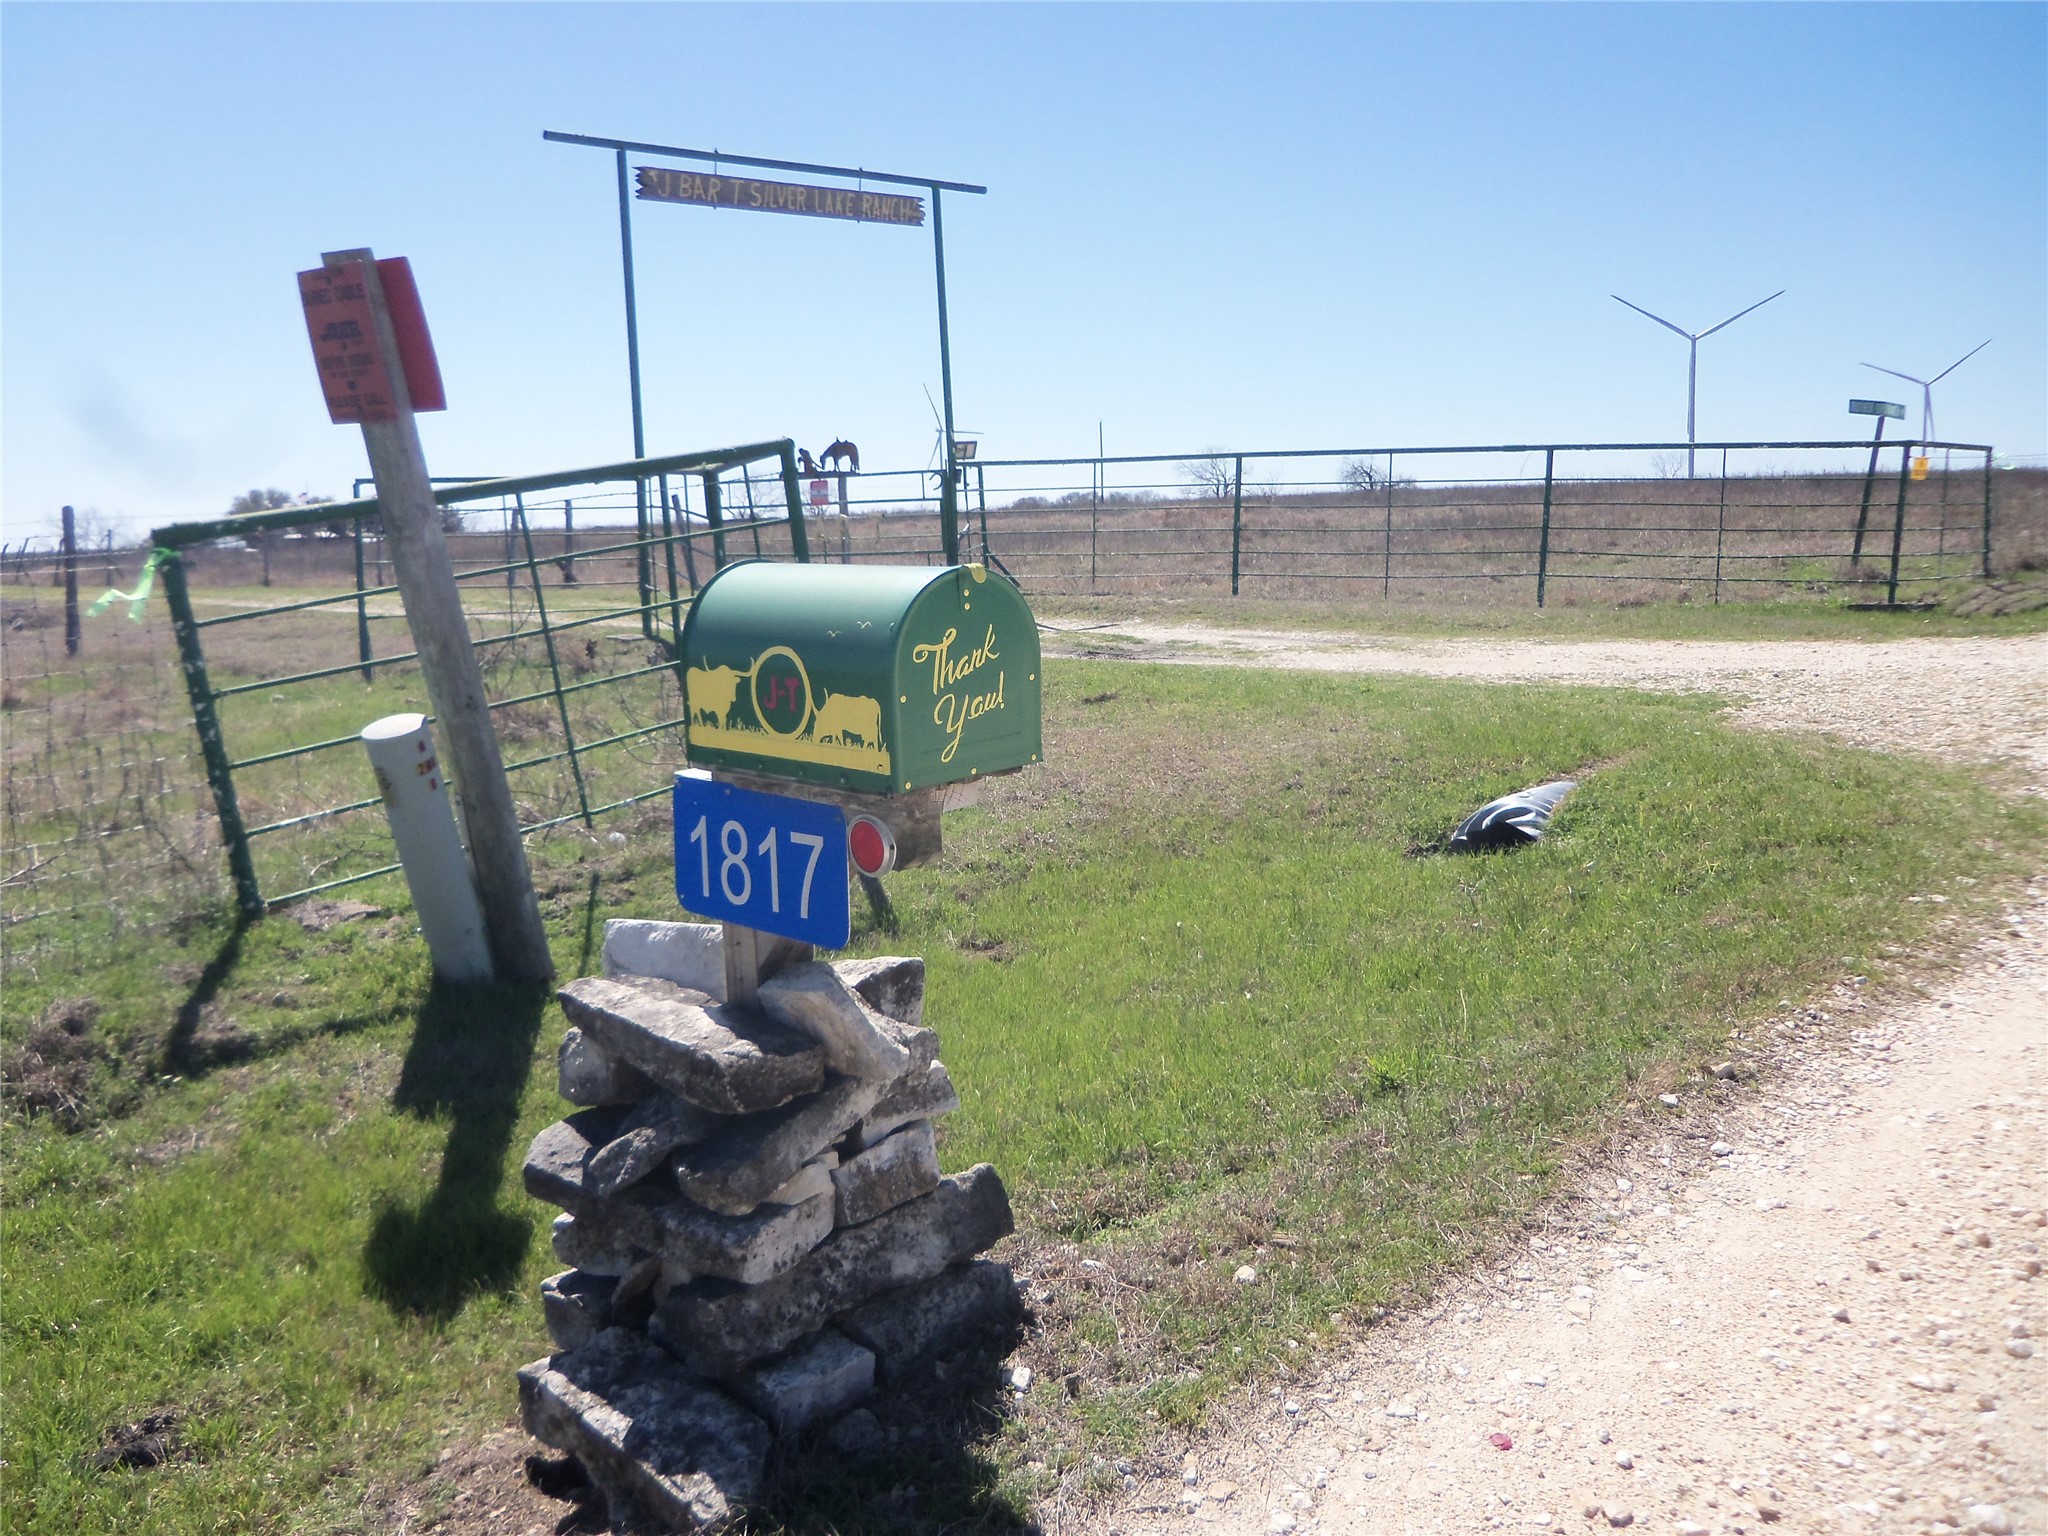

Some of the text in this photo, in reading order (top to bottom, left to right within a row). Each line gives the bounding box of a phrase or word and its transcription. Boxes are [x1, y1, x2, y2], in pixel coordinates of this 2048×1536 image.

[679, 176, 721, 203] BAR
[730, 178, 745, 205] T
[750, 182, 807, 212] SILVER
[814, 189, 854, 217] LAKE
[862, 194, 911, 222] RANCH
[912, 624, 1000, 695] Thank
[933, 671, 1006, 763] You!
[690, 815, 825, 920] 1817
